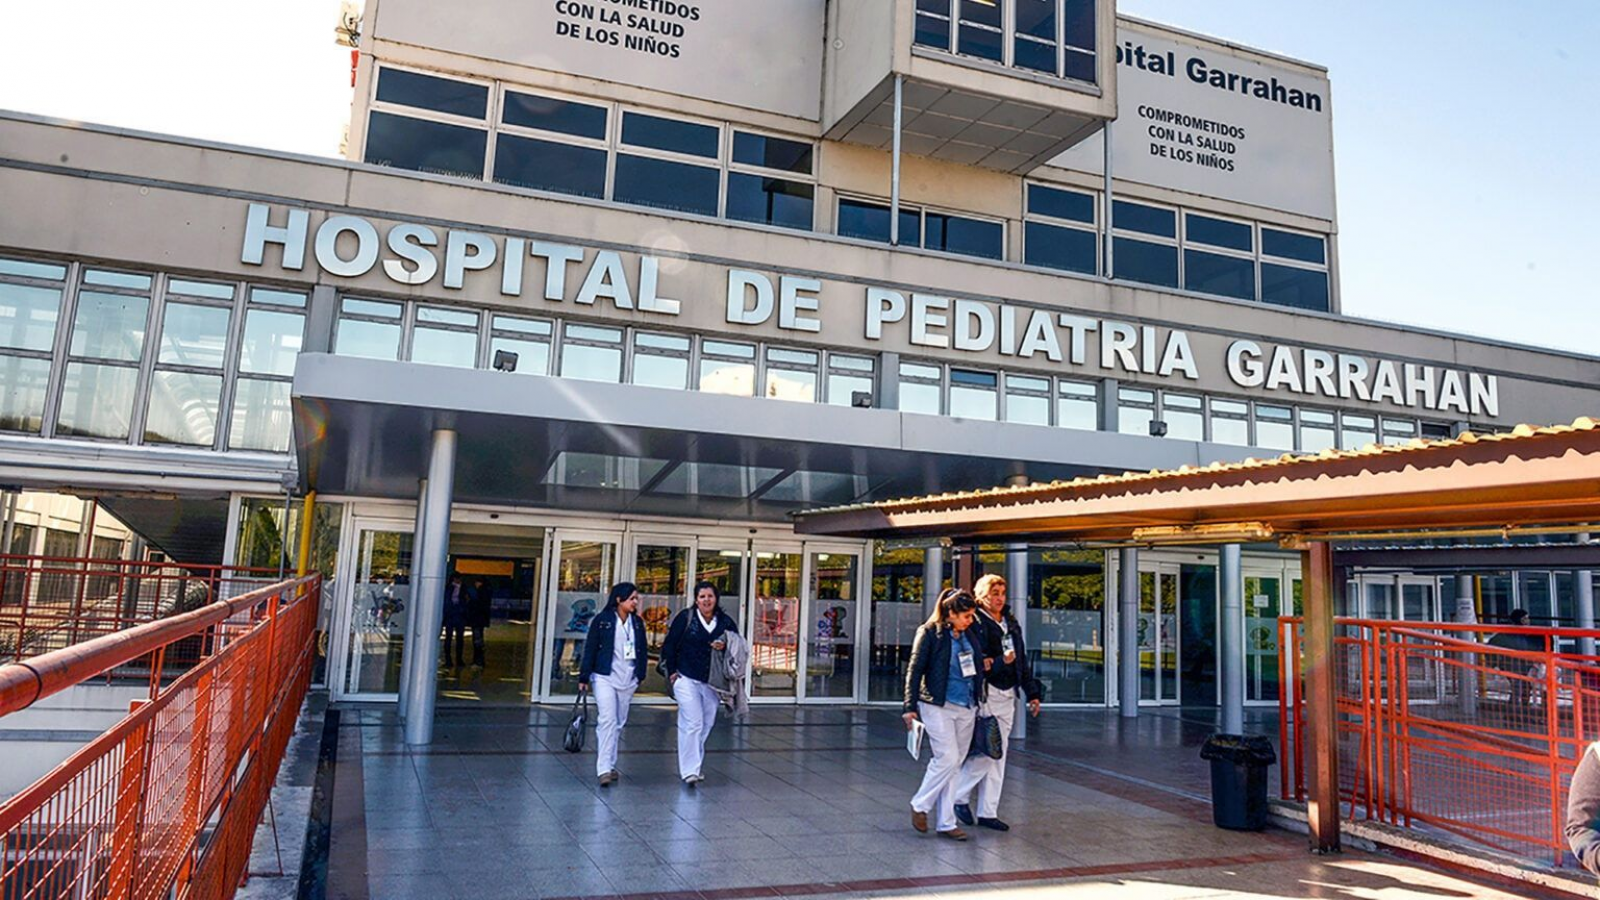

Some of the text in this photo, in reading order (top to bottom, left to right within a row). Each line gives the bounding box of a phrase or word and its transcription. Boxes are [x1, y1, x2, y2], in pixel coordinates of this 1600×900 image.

[555, 0, 685, 38] CON LA SALUD
[556, 21, 680, 58] DE LOS NIÑOS
[1186, 57, 1322, 112] Garrahan
[1138, 105, 1245, 140] COMPROMETIDOS
[1148, 125, 1236, 155] CON LA SALUD
[1150, 143, 1235, 172] DE LOS NIÑOS
[241, 203, 1499, 417] HOSPITAL DE PEDIATRIA GARRAHAN
